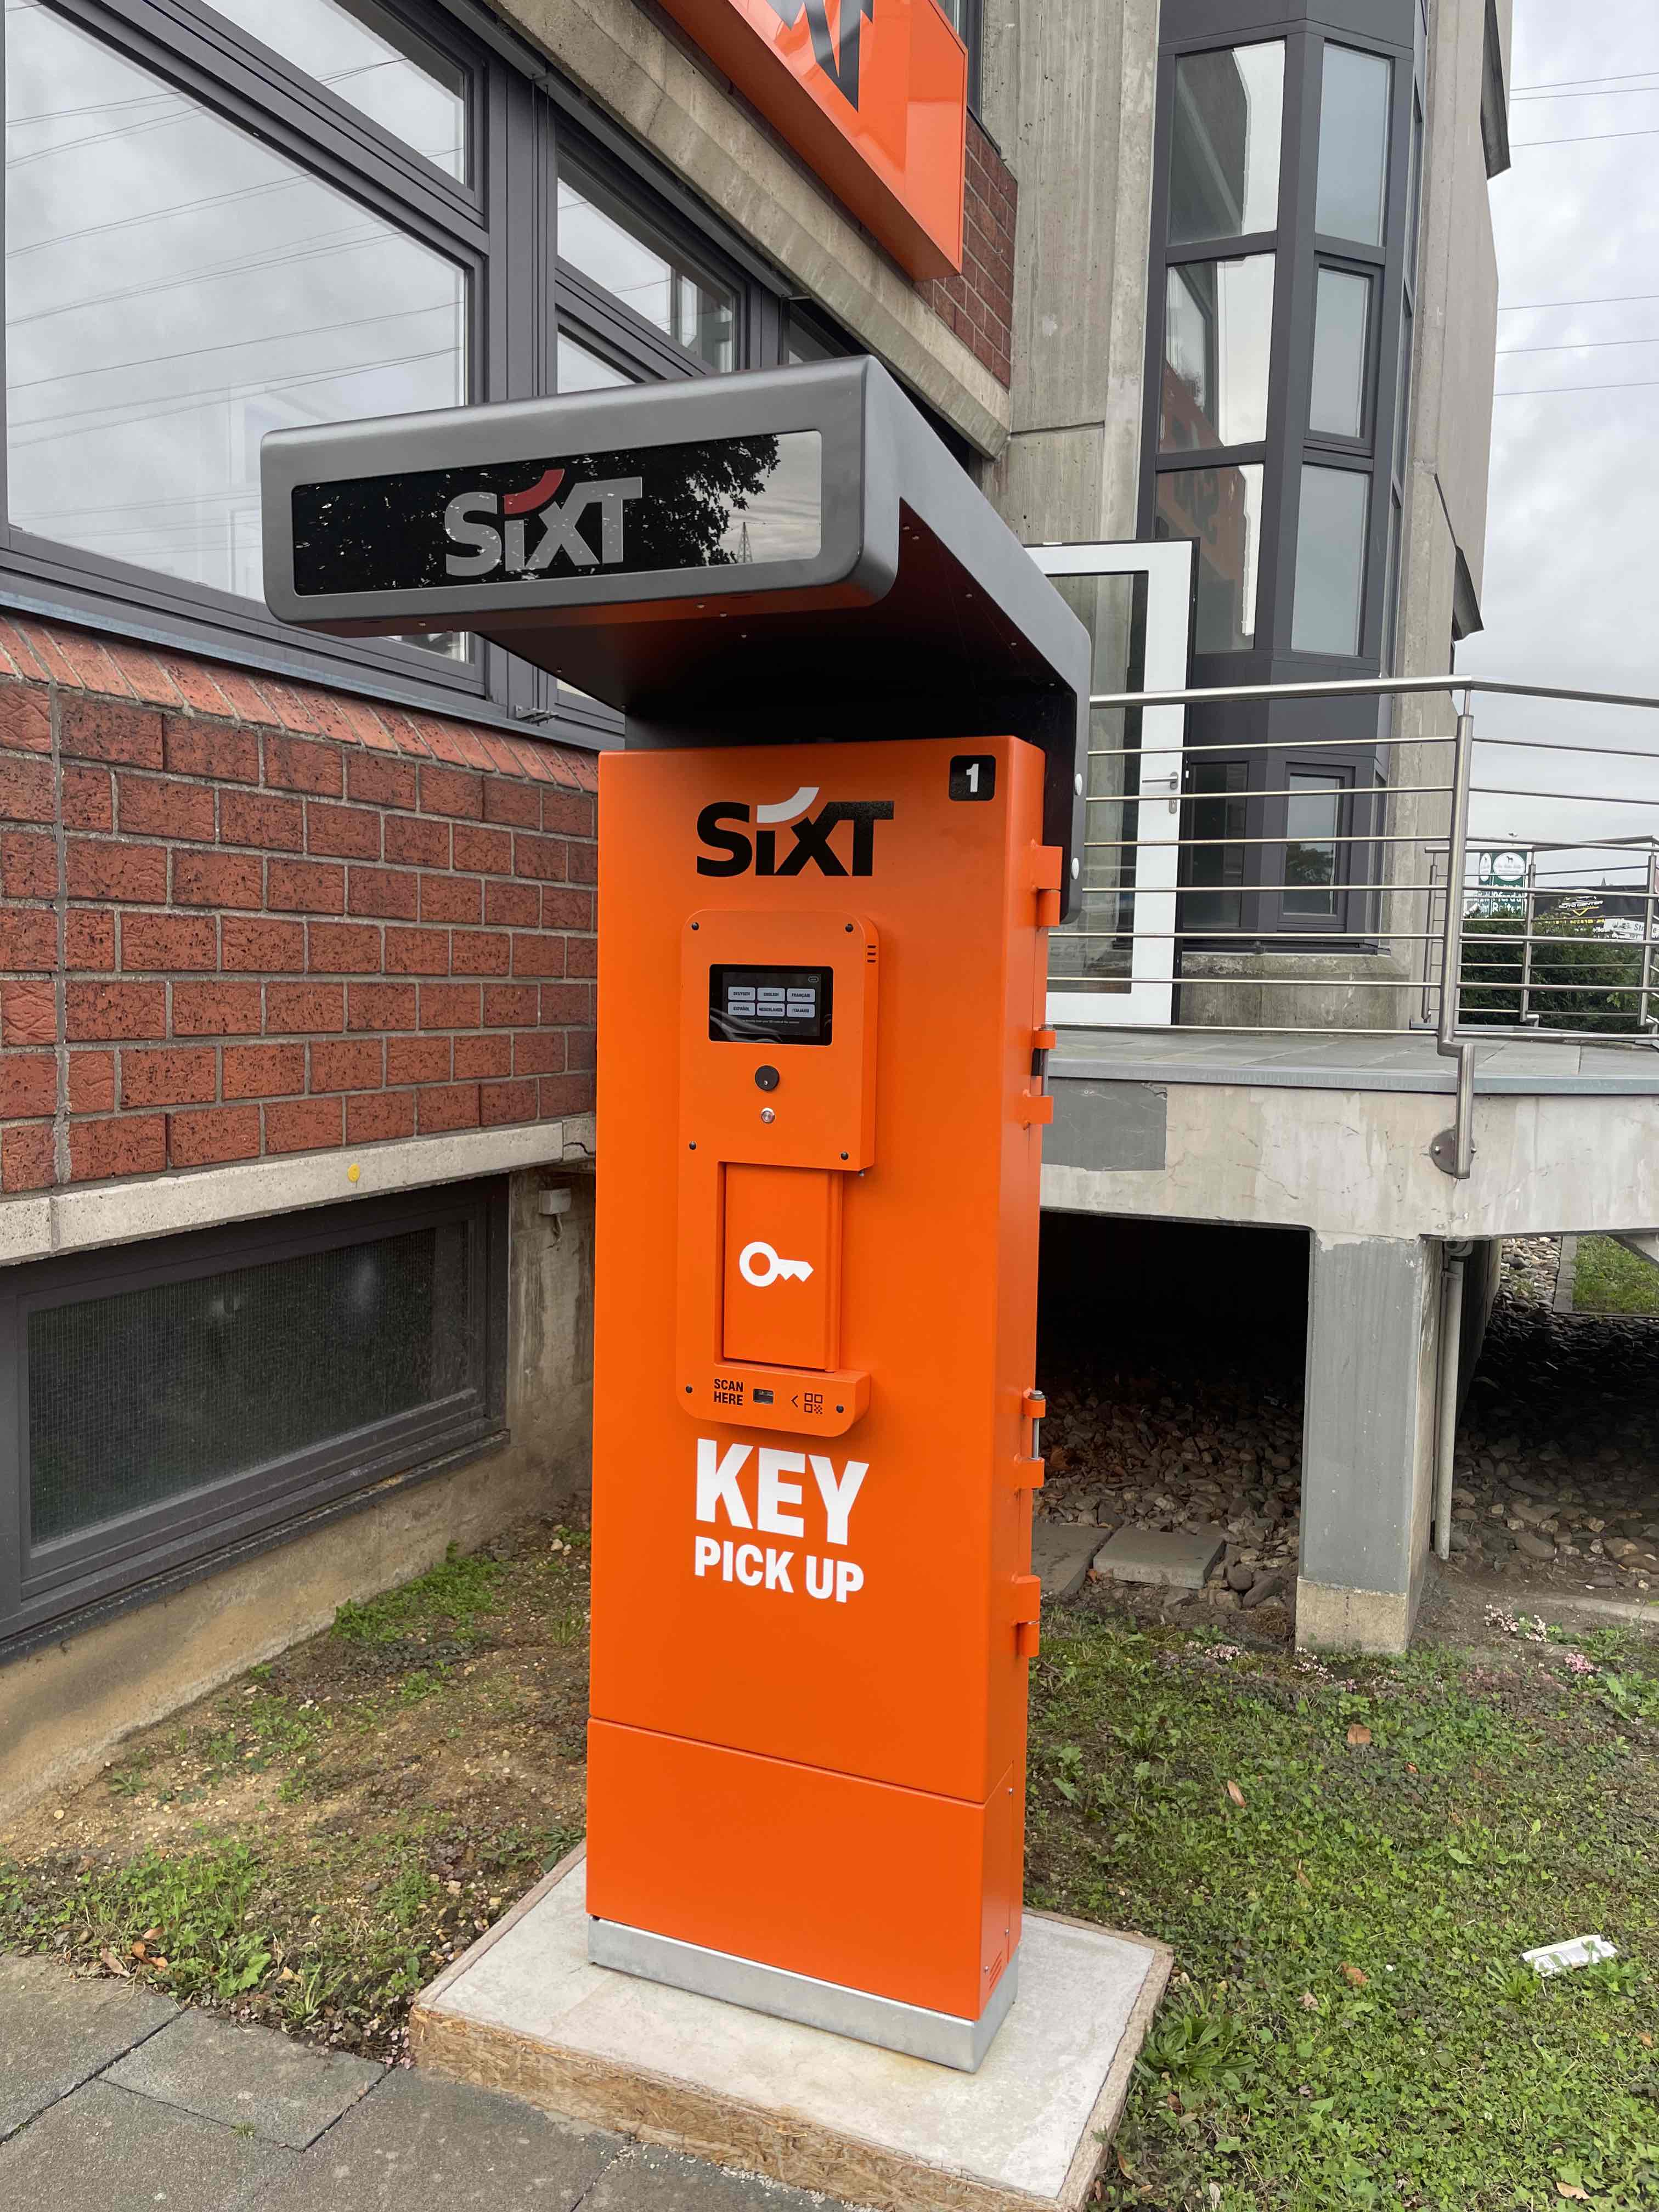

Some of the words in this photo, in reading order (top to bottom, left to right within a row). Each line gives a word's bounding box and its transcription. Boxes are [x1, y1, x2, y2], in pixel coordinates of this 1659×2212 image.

[966, 763, 979, 793] 1
[713, 1391, 743, 1406] HERE
[714, 1378, 743, 1392] SCAN
[696, 1438, 870, 1546] KEY
[694, 1536, 795, 1594] PICK
[805, 1555, 865, 1604] UP
